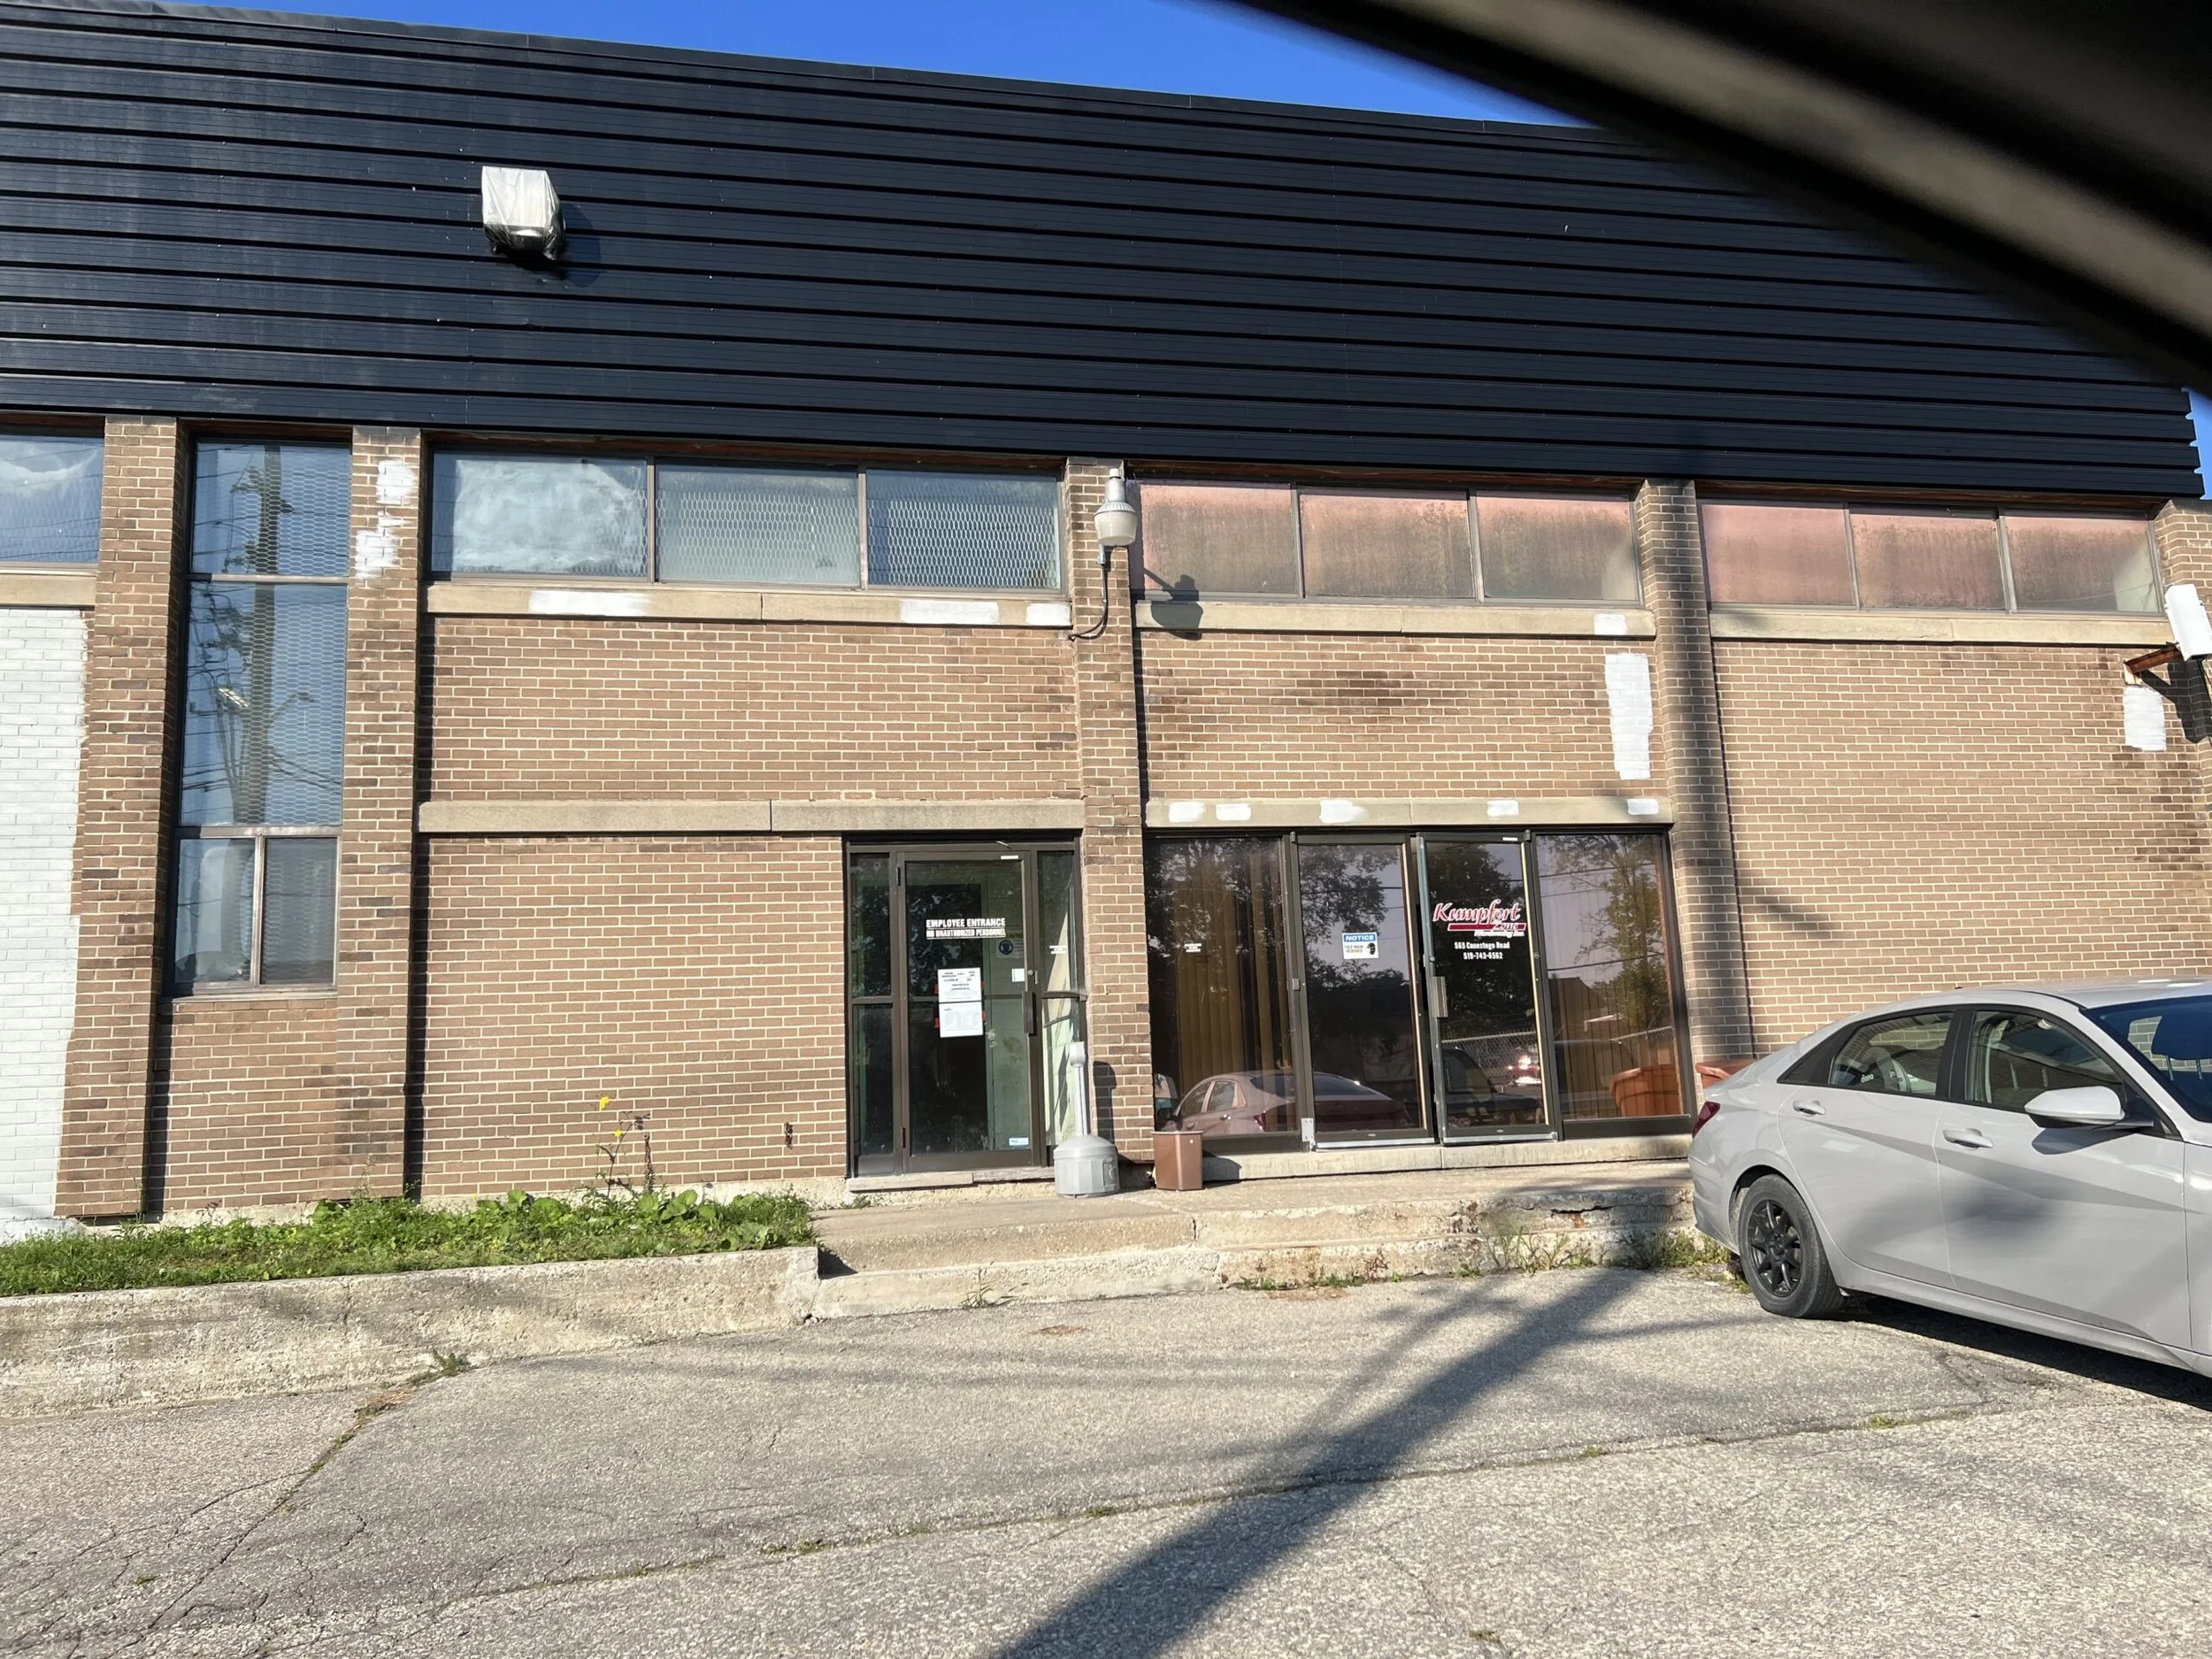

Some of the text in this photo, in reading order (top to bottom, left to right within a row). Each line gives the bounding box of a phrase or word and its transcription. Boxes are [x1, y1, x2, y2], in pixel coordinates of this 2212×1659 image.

[1432, 899, 1521, 925] Kumpfort
[926, 918, 1006, 927] EMPLOYEE ENTRANCE
[1493, 920, 1519, 930] Zone
